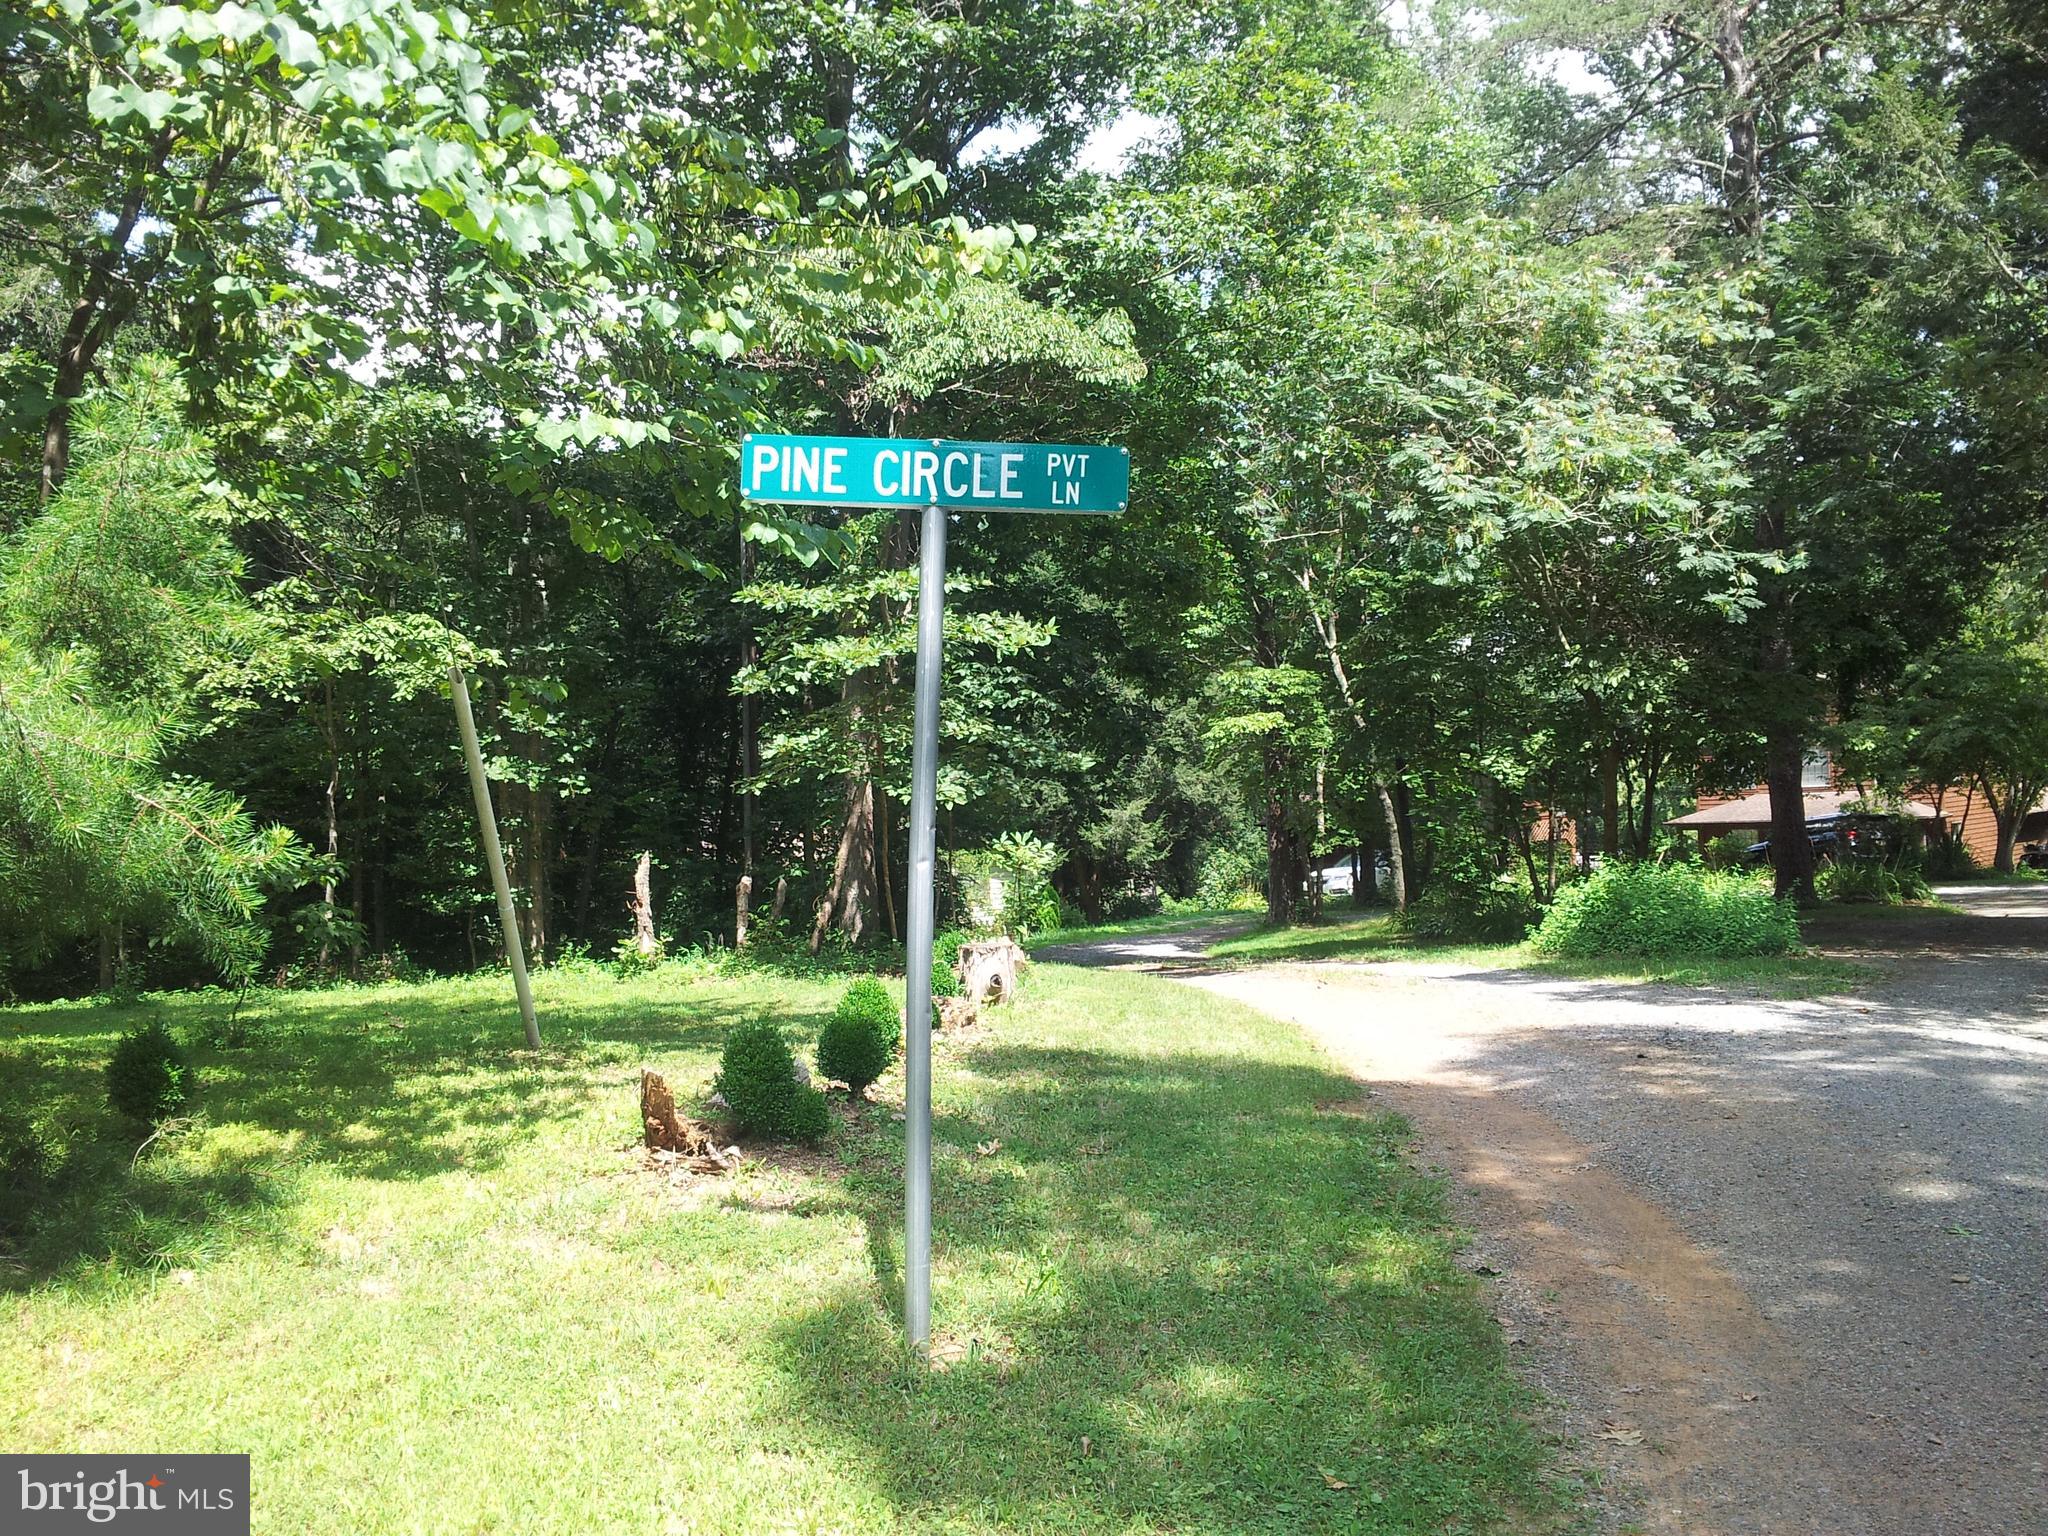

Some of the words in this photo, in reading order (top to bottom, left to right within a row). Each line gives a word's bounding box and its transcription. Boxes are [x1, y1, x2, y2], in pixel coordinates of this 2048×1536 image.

[752, 445, 848, 494] PINE
[873, 450, 1024, 498] CIRCLE
[1046, 453, 1090, 478] PVT
[1051, 482, 1080, 505] LN
